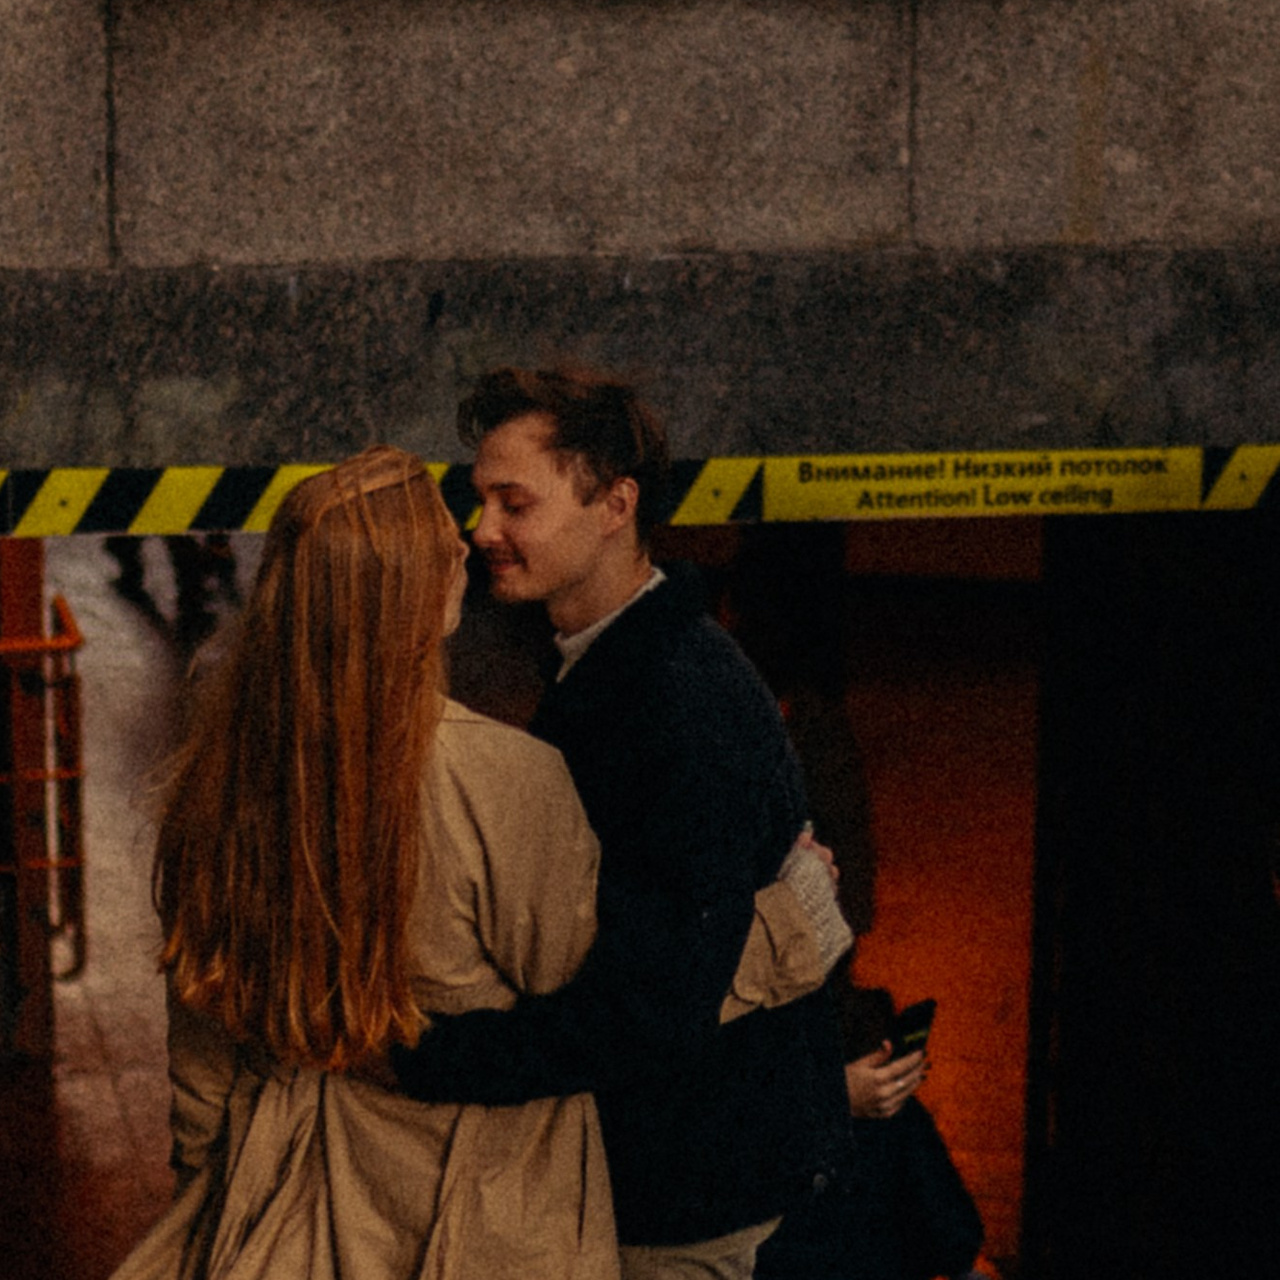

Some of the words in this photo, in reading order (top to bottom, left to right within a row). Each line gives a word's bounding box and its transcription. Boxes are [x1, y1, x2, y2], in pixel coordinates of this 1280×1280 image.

[798, 459, 945, 483] Внимание!
[953, 456, 1052, 480] Низкий
[1060, 455, 1169, 475] потолок
[857, 486, 977, 510] Attention!
[984, 484, 1032, 507] Low
[1039, 481, 1113, 507] ceiling
